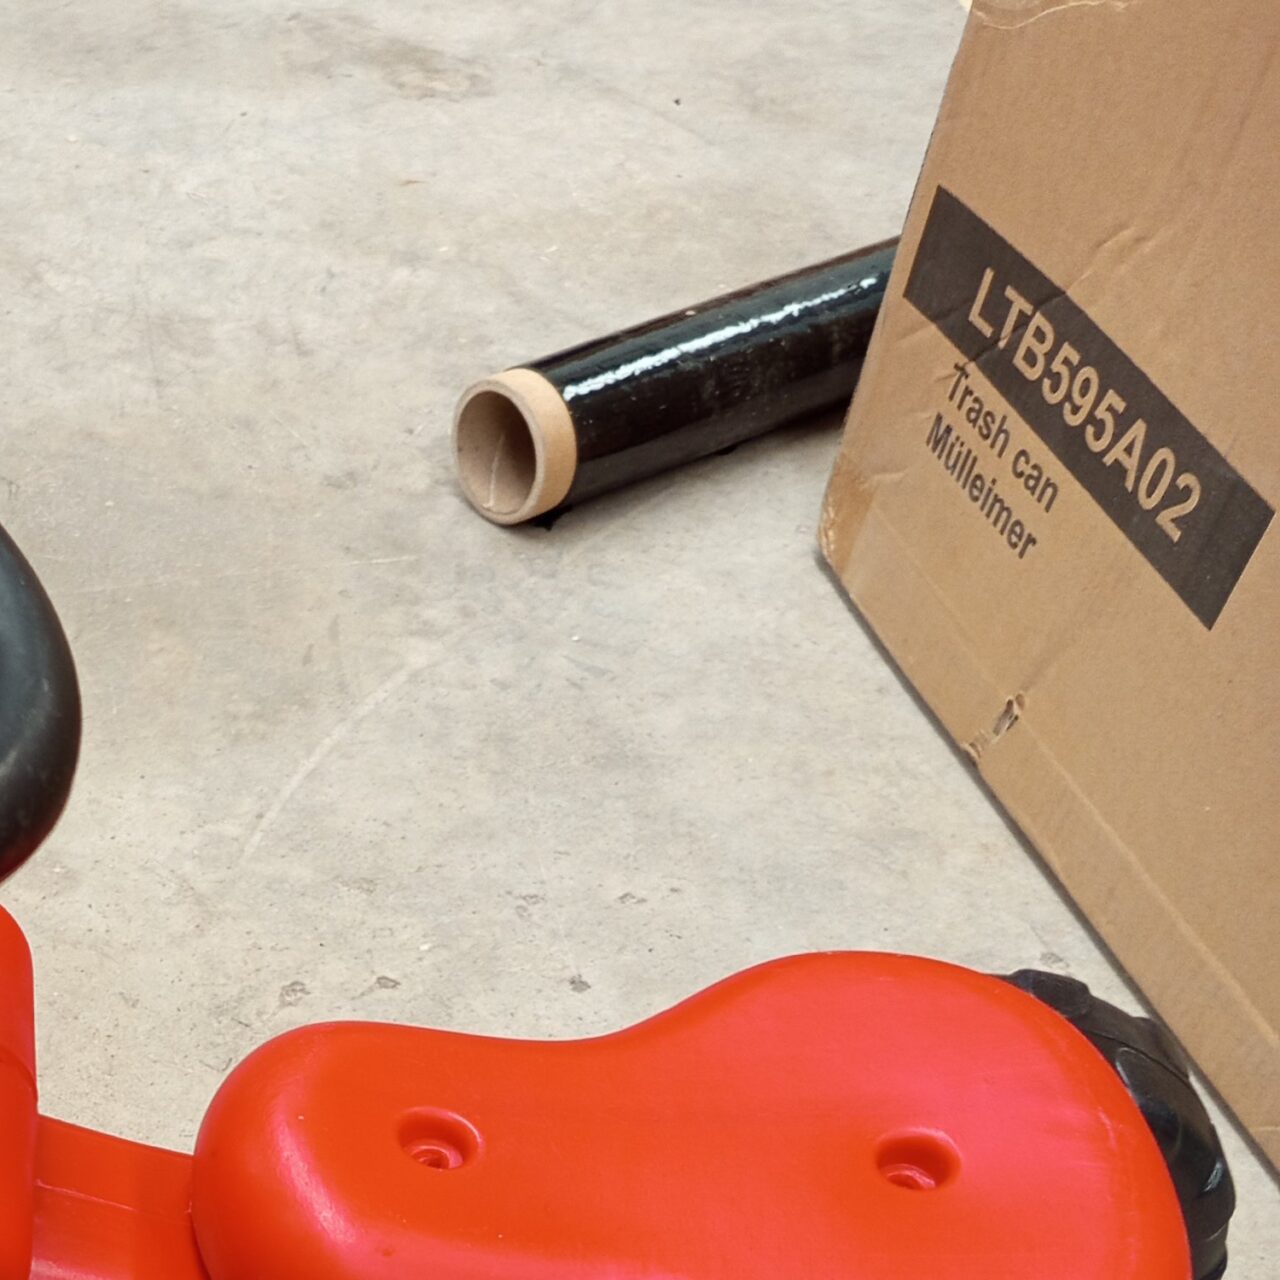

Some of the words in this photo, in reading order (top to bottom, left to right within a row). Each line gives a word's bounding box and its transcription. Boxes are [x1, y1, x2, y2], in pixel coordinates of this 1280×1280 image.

[947, 363, 1011, 460] Trash
[1013, 447, 1059, 513] can
[967, 266, 1202, 543] LTB595A02
[925, 413, 1037, 558] Mülleimer
